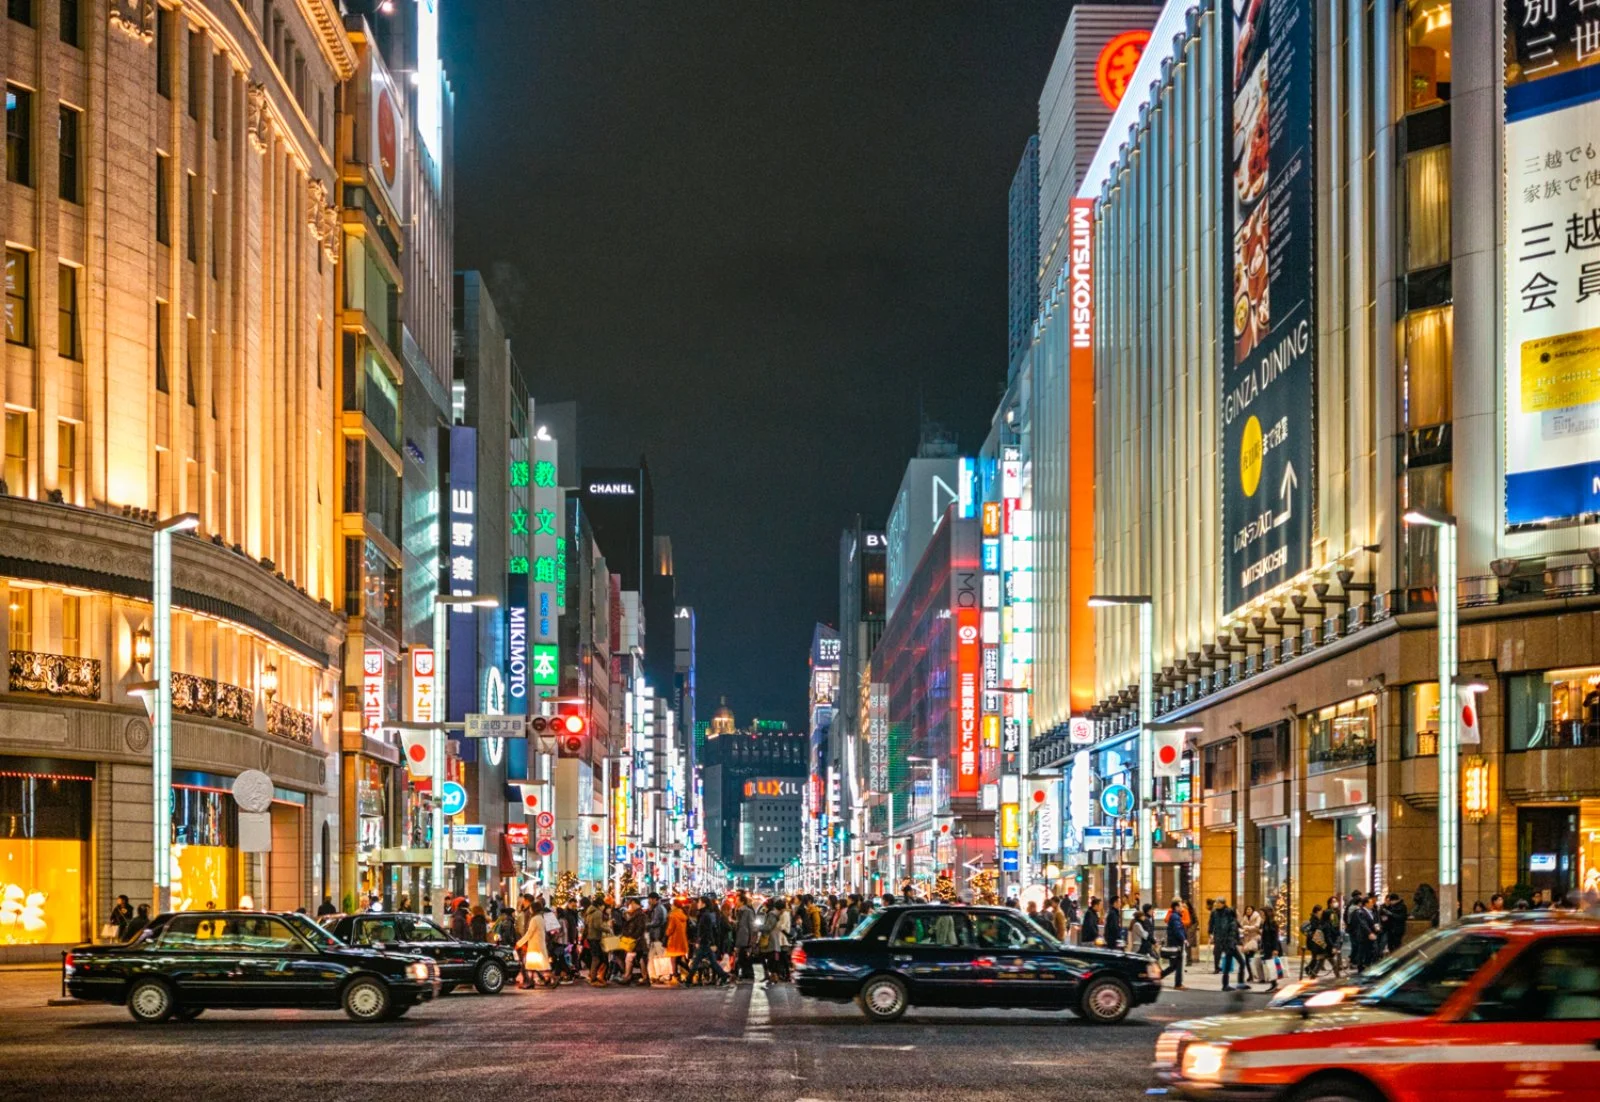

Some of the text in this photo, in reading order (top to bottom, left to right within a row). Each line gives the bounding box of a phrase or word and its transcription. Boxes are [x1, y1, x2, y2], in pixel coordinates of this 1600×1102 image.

[1519, 207, 1600, 262] 三越
[1073, 207, 1091, 348] MITSUKOSHI
[1225, 319, 1309, 425] GINZA DINING
[533, 460, 556, 583] 教文館
[589, 484, 636, 495] CHANEL
[1242, 544, 1289, 589] MITSUKOSHI
[511, 606, 526, 698] MIKIMOTO
[534, 651, 556, 679] 本
